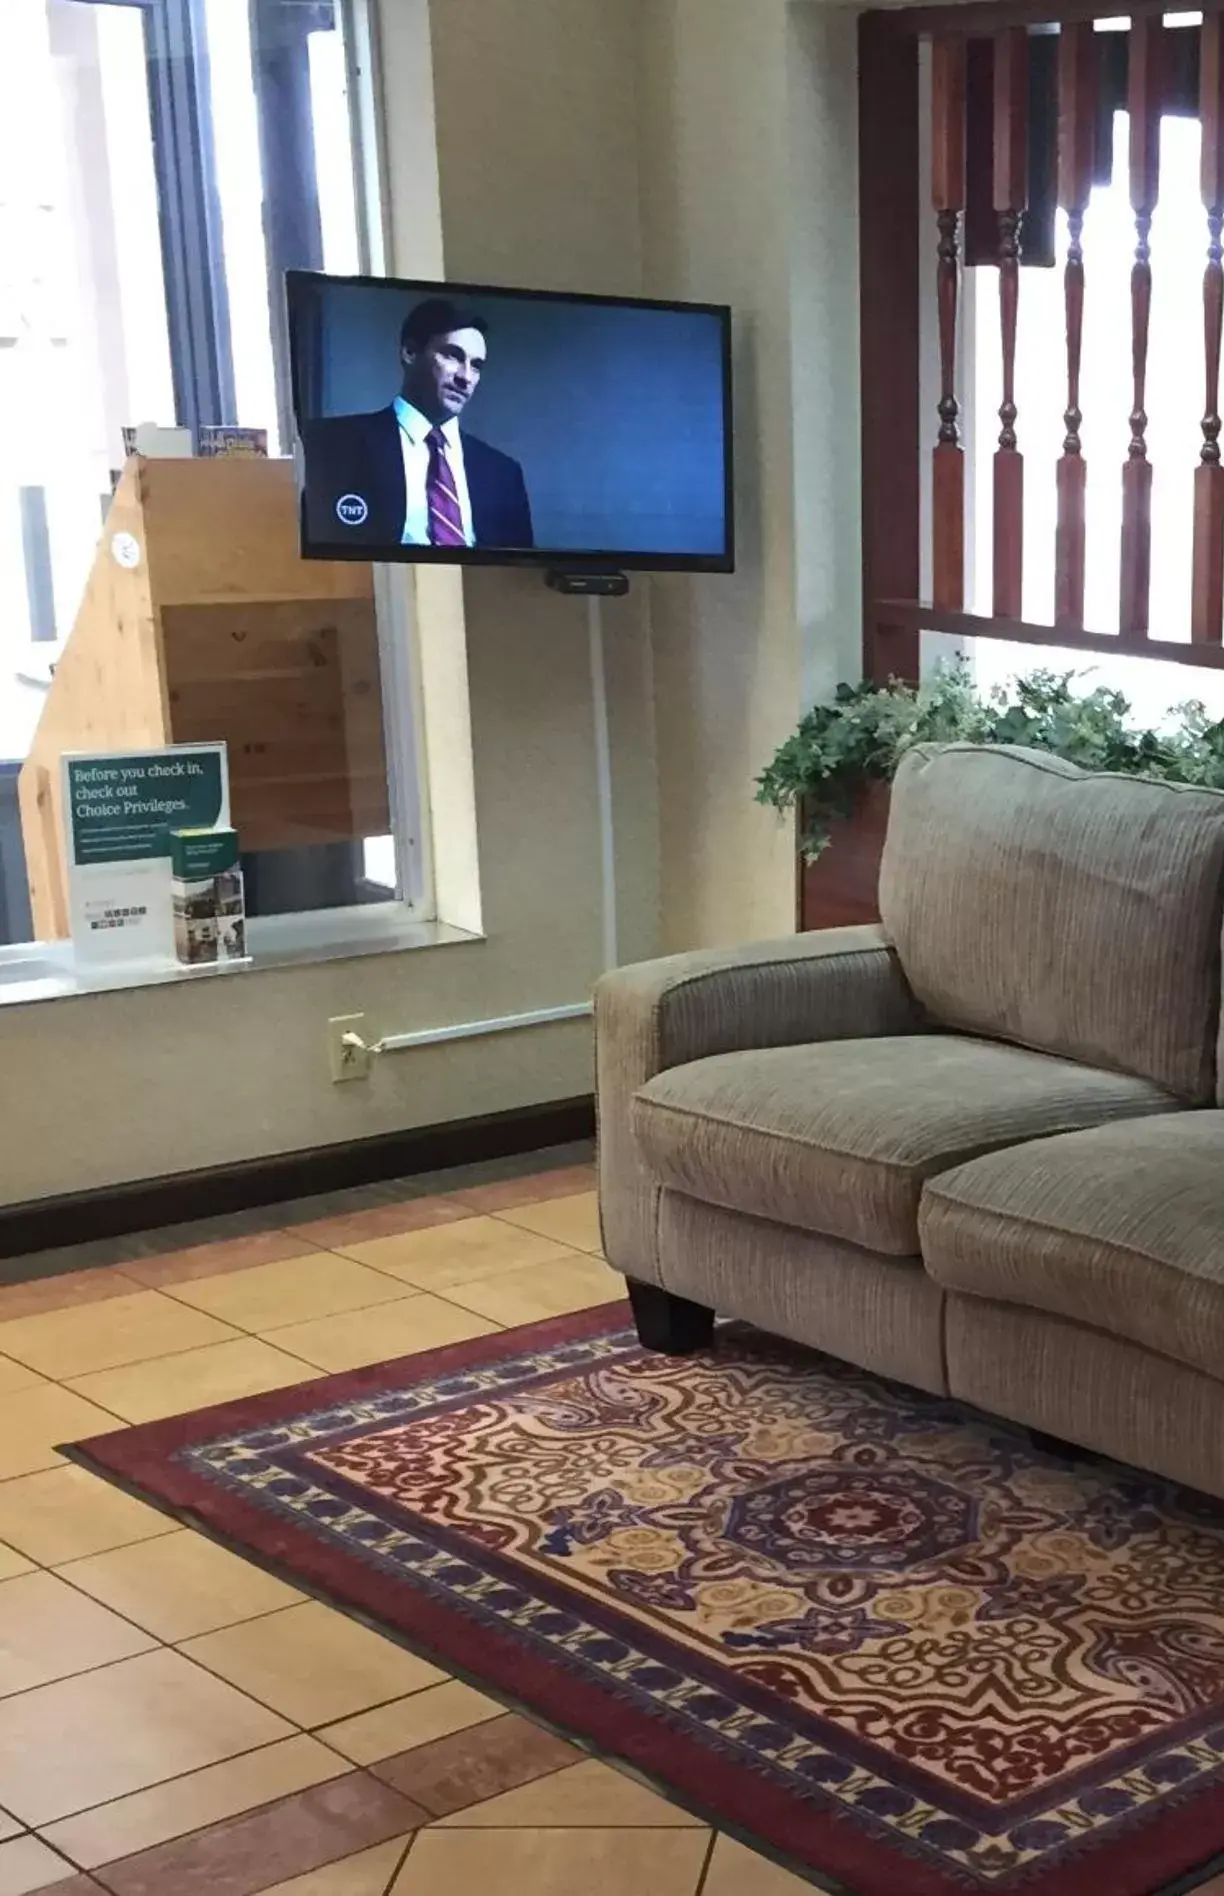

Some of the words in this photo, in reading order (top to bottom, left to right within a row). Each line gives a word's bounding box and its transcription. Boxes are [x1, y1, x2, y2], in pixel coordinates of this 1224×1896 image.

[340, 505, 363, 516] TNT
[74, 767, 118, 782] Before
[120, 768, 145, 782] you
[147, 762, 184, 777] check
[75, 786, 113, 800] check
[116, 785, 138, 797] out
[76, 802, 120, 818] Choice
